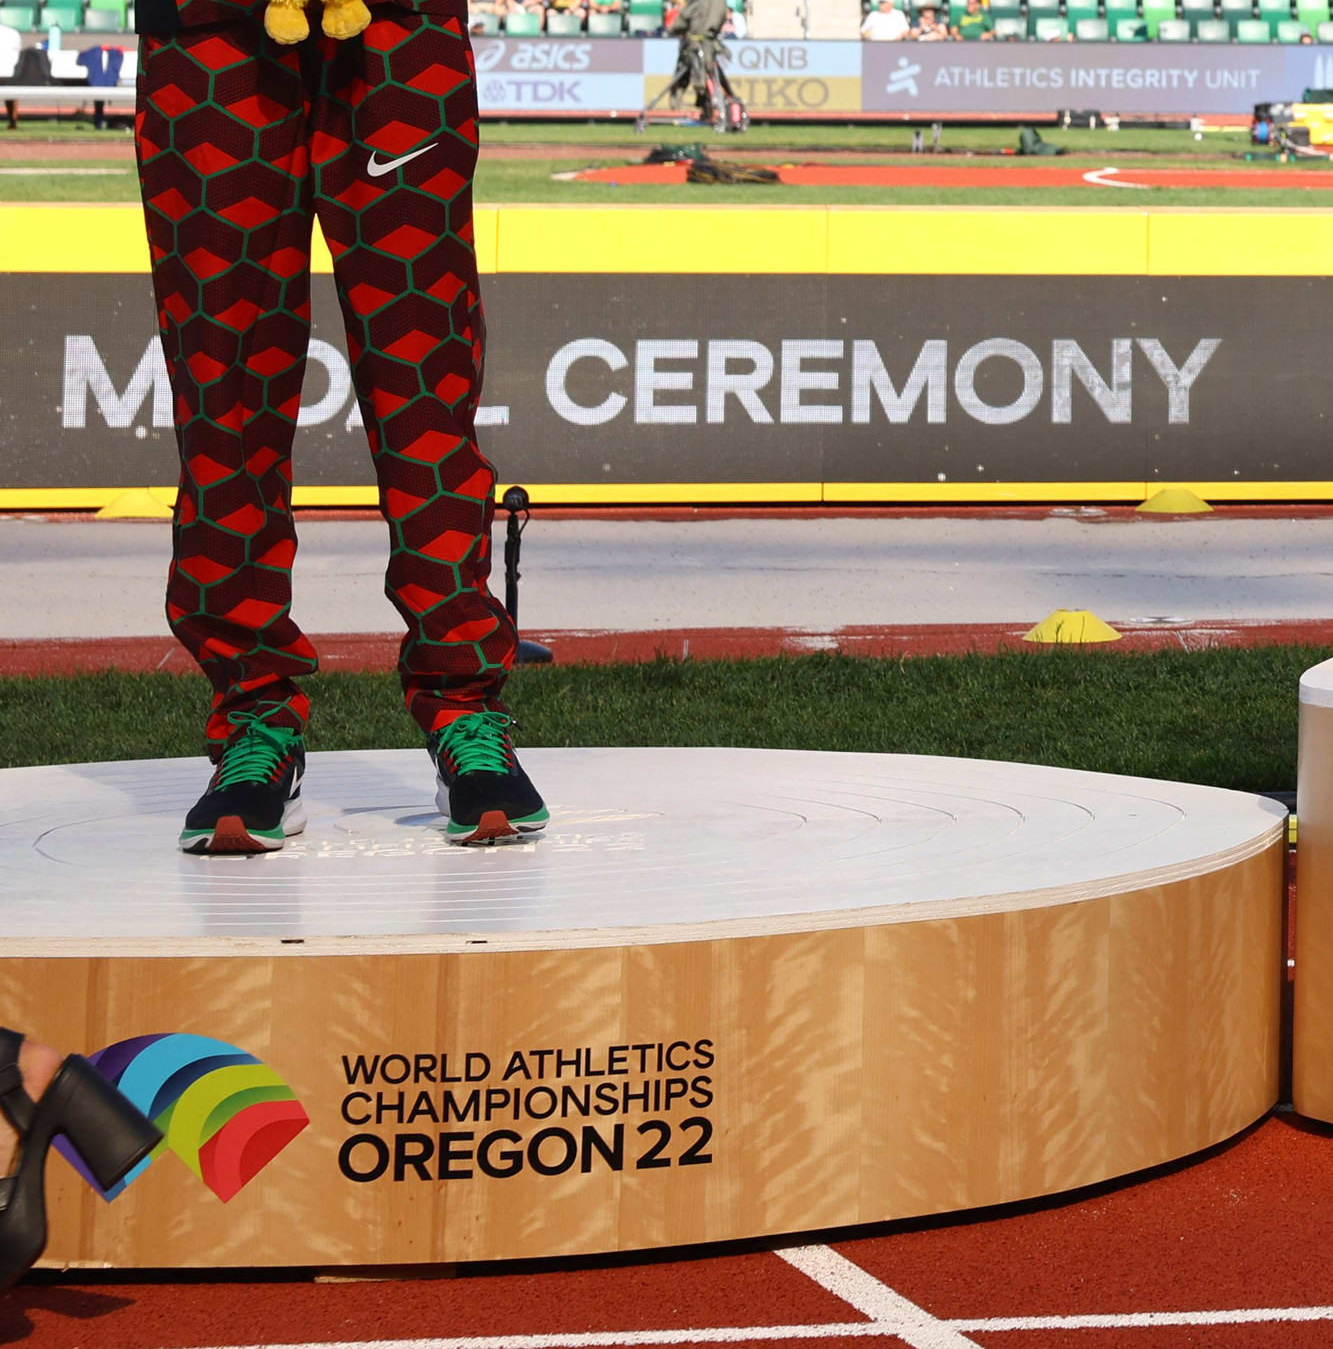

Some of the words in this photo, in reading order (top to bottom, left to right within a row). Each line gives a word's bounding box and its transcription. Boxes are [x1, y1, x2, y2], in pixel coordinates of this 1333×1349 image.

[511, 43, 592, 70] asics
[738, 46, 808, 70] QNB
[505, 80, 583, 102] TDK
[933, 67, 1062, 88] ATHLETICS
[1069, 68, 1198, 89] INTEGRITY
[1206, 69, 1261, 89] UNIT
[545, 336, 1222, 427] CEREMONY
[342, 1052, 491, 1085] WORLD
[502, 1039, 715, 1081] ATHLETICS
[341, 1075, 714, 1126] CHAMPIONSHIPS
[338, 1116, 713, 1183] OREGON22
